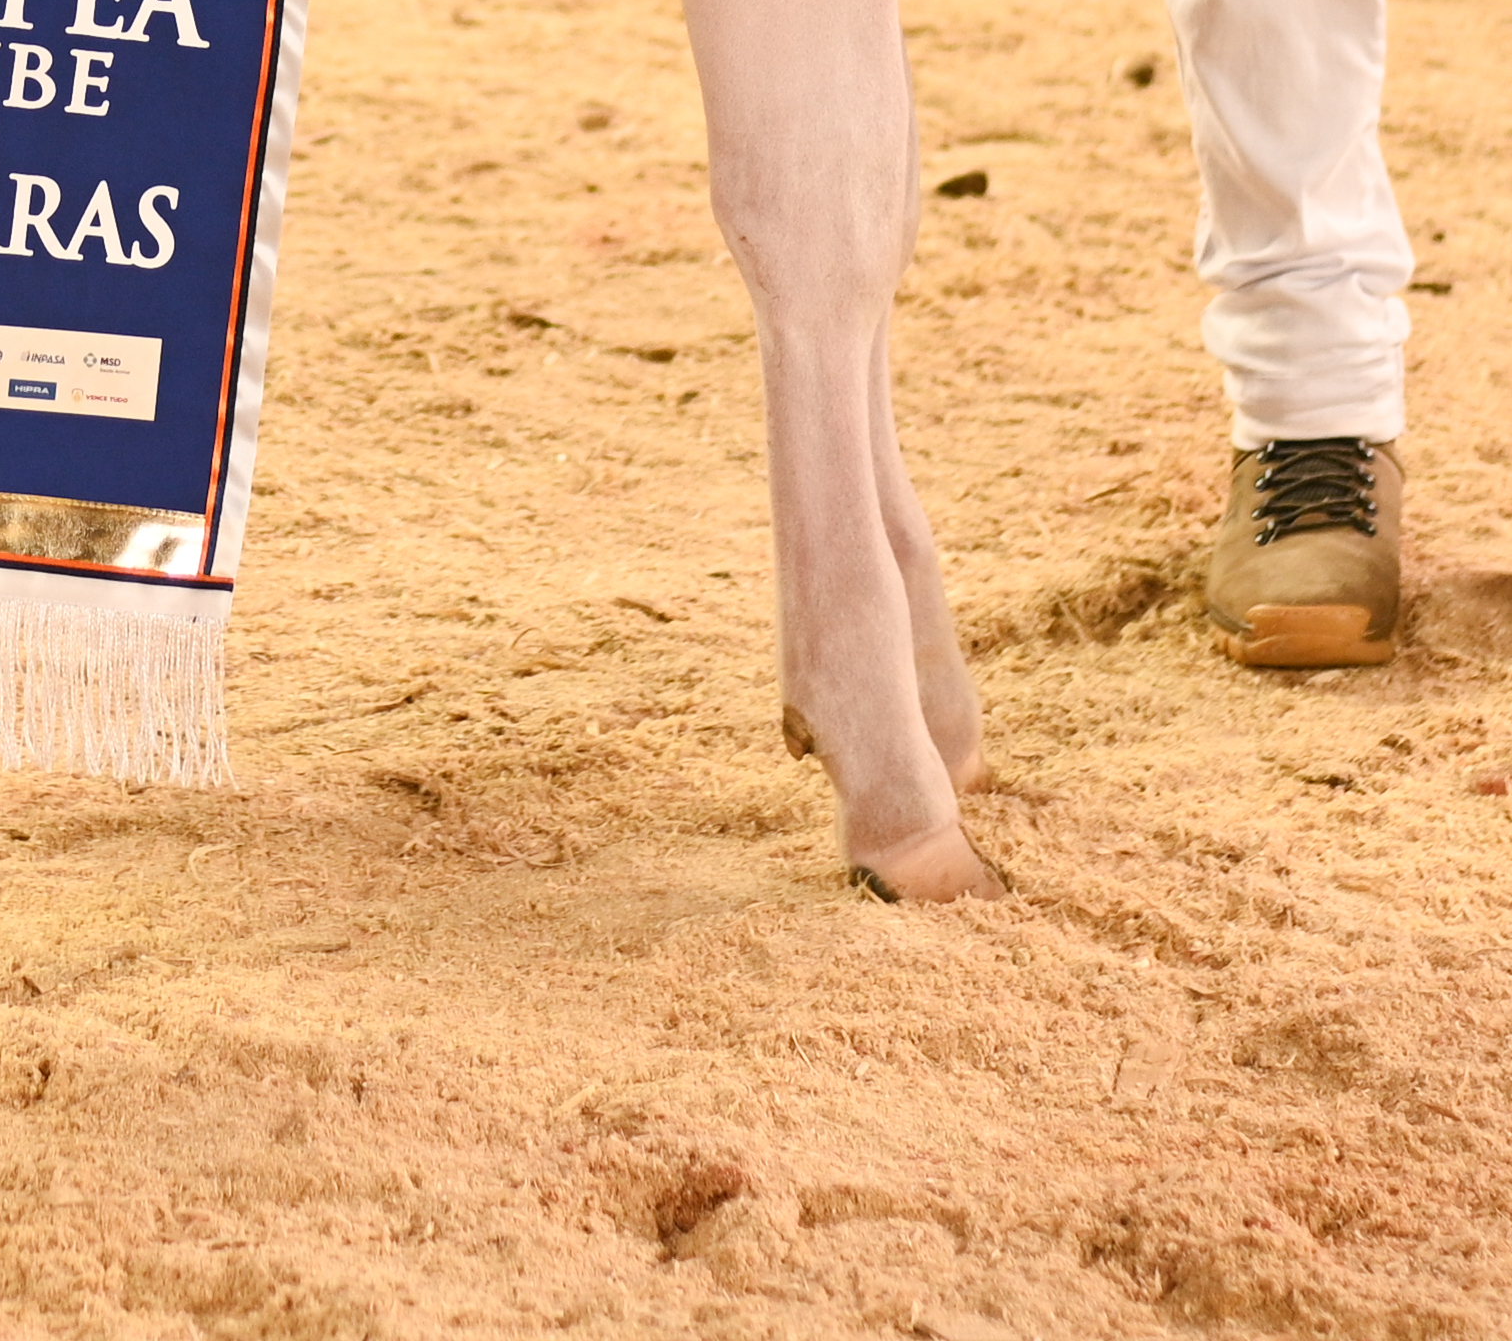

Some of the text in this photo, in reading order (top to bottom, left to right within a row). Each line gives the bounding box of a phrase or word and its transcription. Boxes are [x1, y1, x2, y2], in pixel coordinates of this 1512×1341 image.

[31, 353, 66, 364] INPASA
[100, 357, 121, 366] MSD
[14, 384, 49, 394] HIPRA
[86, 394, 129, 404] VENCE TUDO
